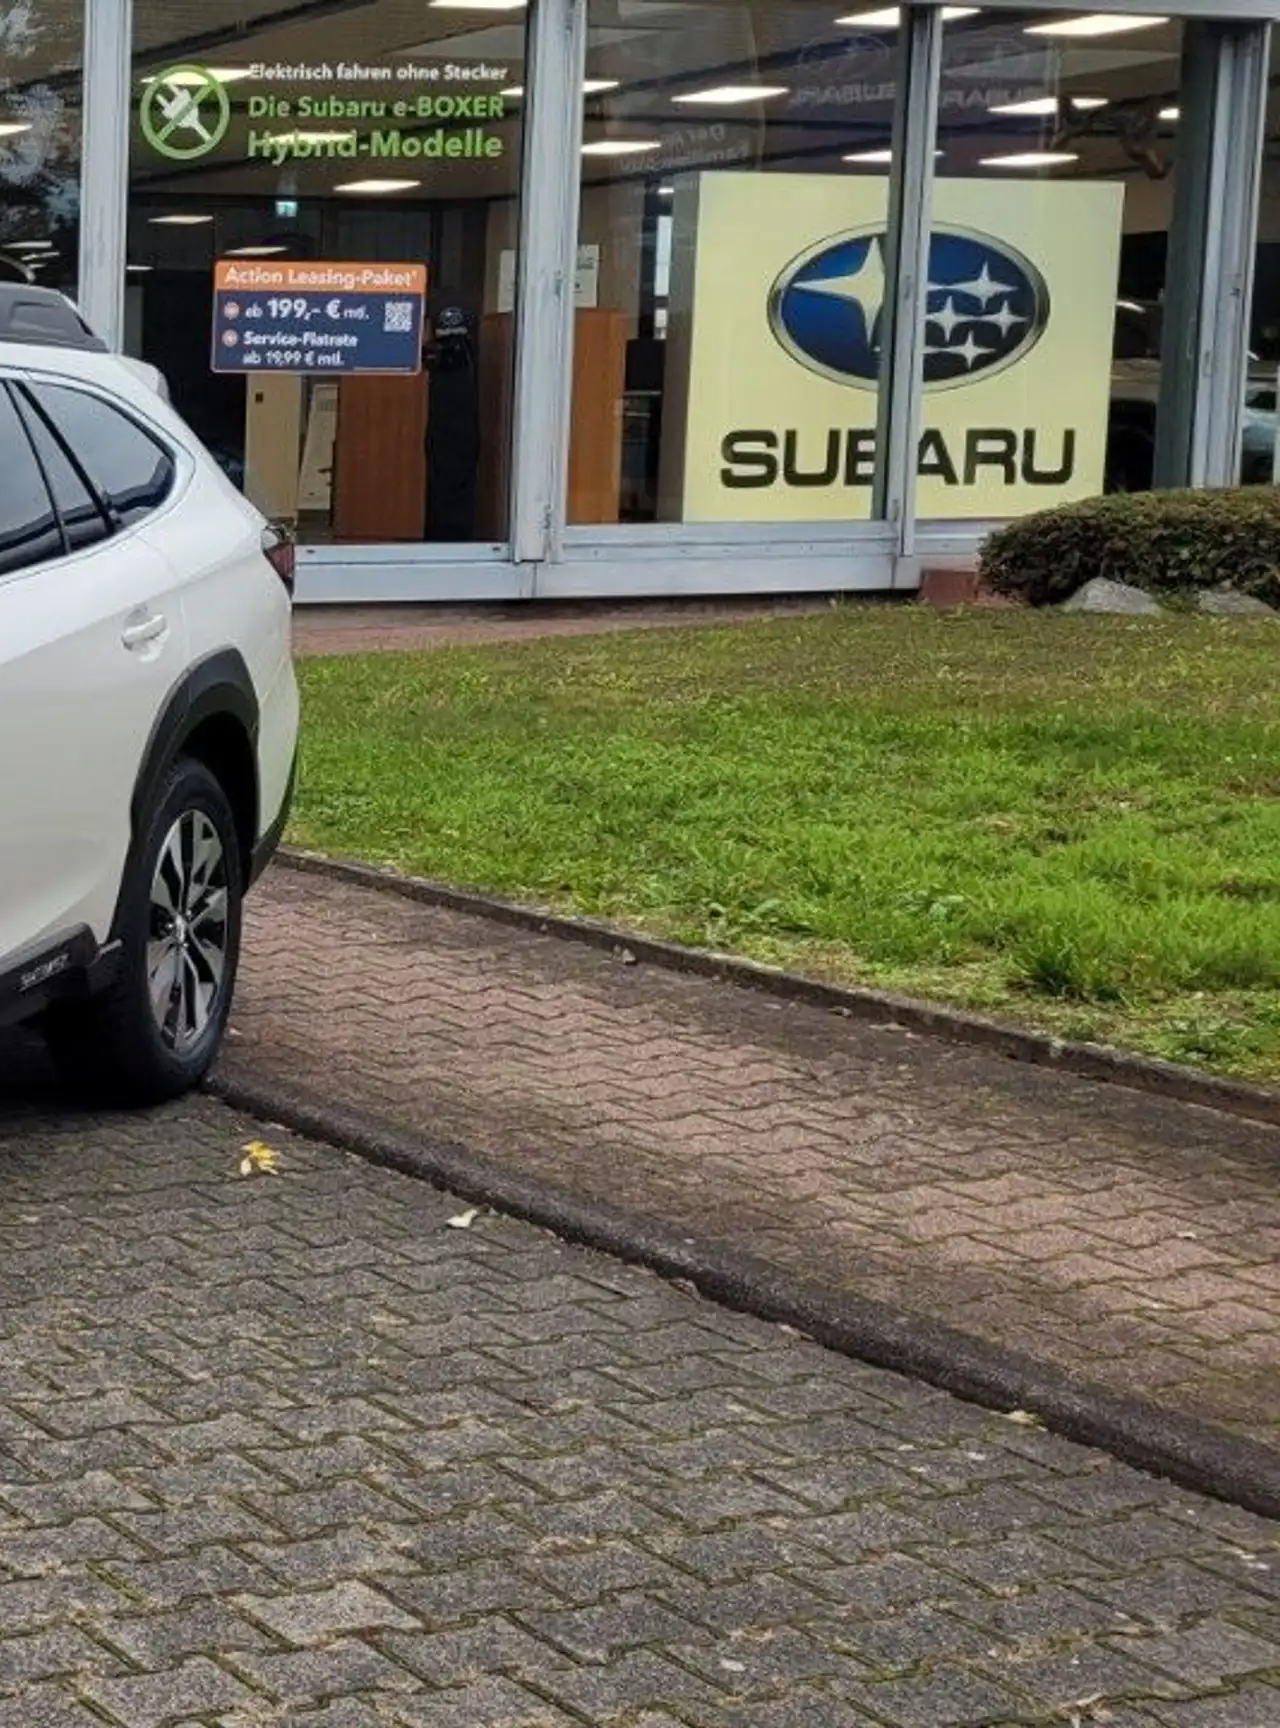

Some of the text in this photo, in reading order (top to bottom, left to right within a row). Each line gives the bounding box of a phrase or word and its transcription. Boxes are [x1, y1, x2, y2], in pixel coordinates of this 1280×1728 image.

[249, 63, 507, 80] Elektrisch fahren ohne Stecker
[249, 95, 504, 117] Die Subaru e-BOXER
[248, 129, 503, 165] Hybrid-Modelle
[225, 267, 283, 284] Action
[245, 301, 263, 318] ab
[326, 298, 341, 319] €
[243, 330, 358, 347] Service-Flatrate
[243, 349, 261, 364] ab
[318, 350, 344, 366] mtl.
[721, 428, 1075, 488] SUBARU
